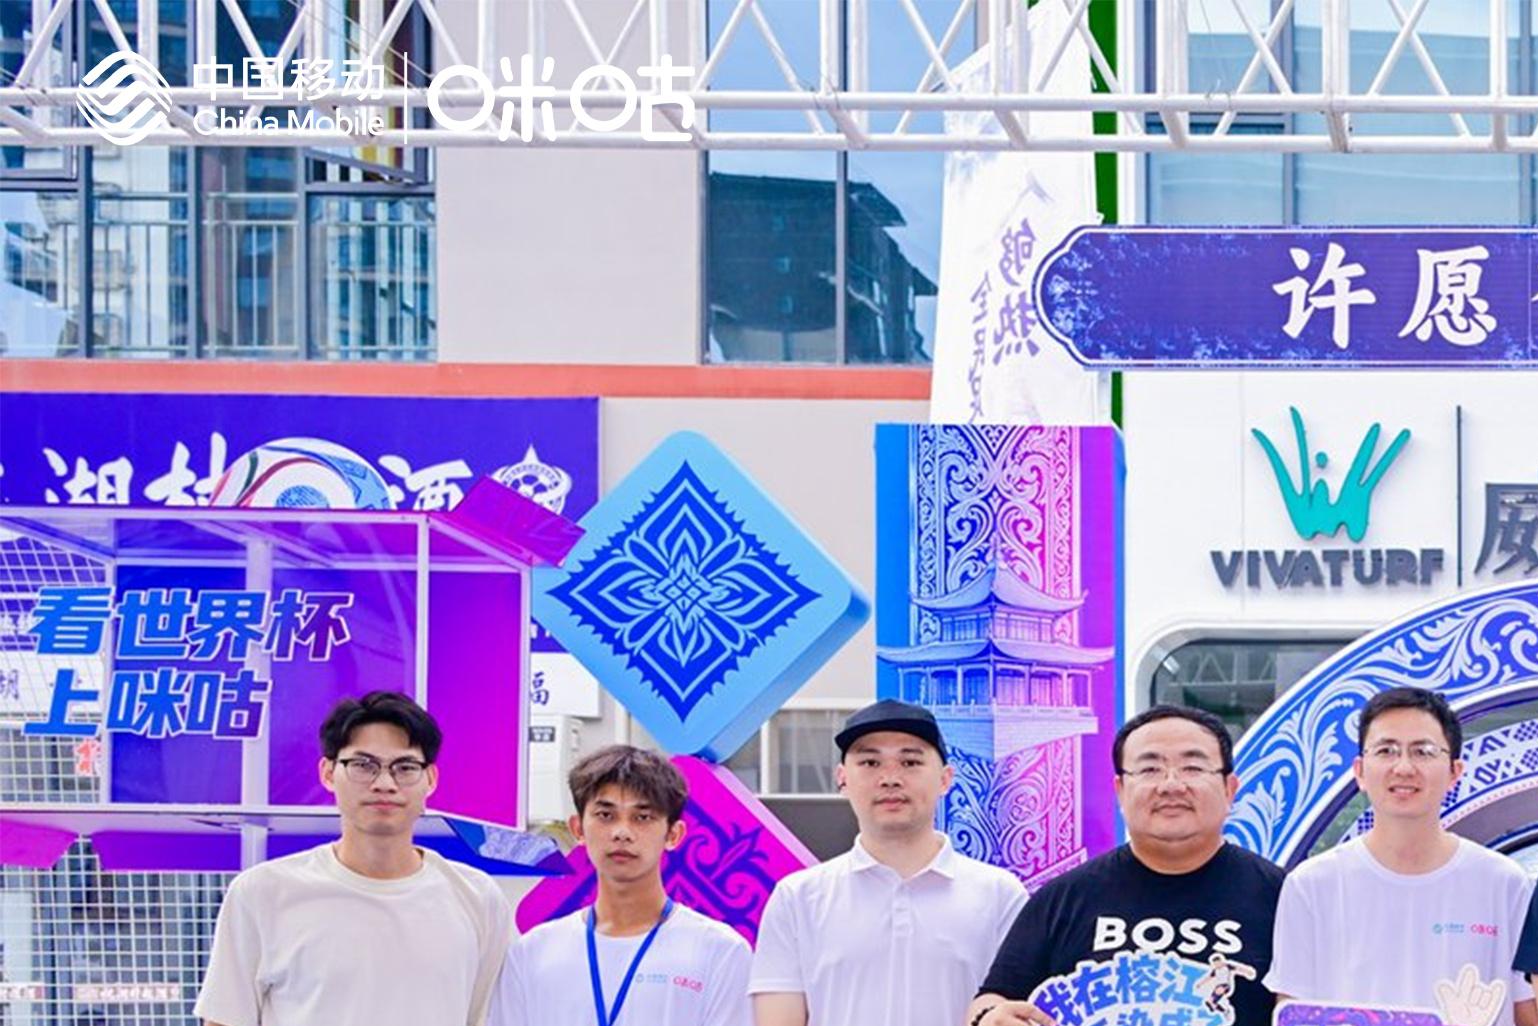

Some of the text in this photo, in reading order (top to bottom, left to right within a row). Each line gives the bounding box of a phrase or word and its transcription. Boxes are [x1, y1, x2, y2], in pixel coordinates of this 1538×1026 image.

[1210, 548, 1445, 588] VIVATURF
[31, 586, 354, 662] 看世界杯
[23, 668, 273, 741] 上咪咕
[1092, 916, 1244, 954] BOSS
